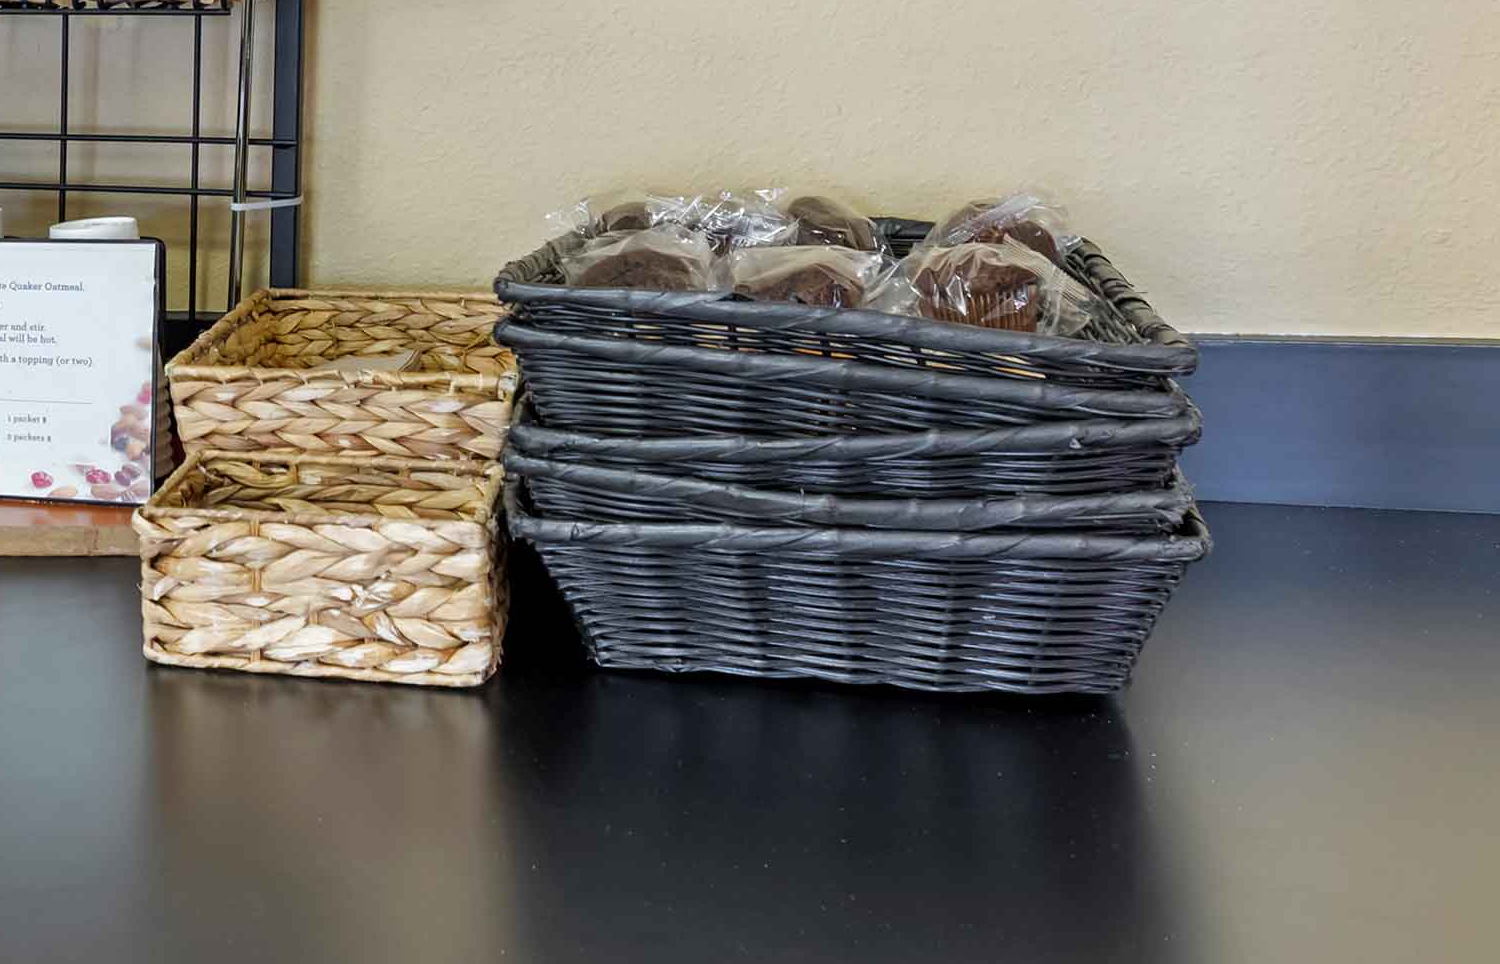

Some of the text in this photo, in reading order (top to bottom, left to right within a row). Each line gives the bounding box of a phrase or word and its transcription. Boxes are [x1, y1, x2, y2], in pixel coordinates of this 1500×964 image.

[9, 281, 42, 292] Quaker
[10, 322, 27, 332] and
[8, 333, 25, 343] will
[27, 334, 38, 344] be
[18, 355, 53, 366] topping
[55, 356, 70, 367] (or
